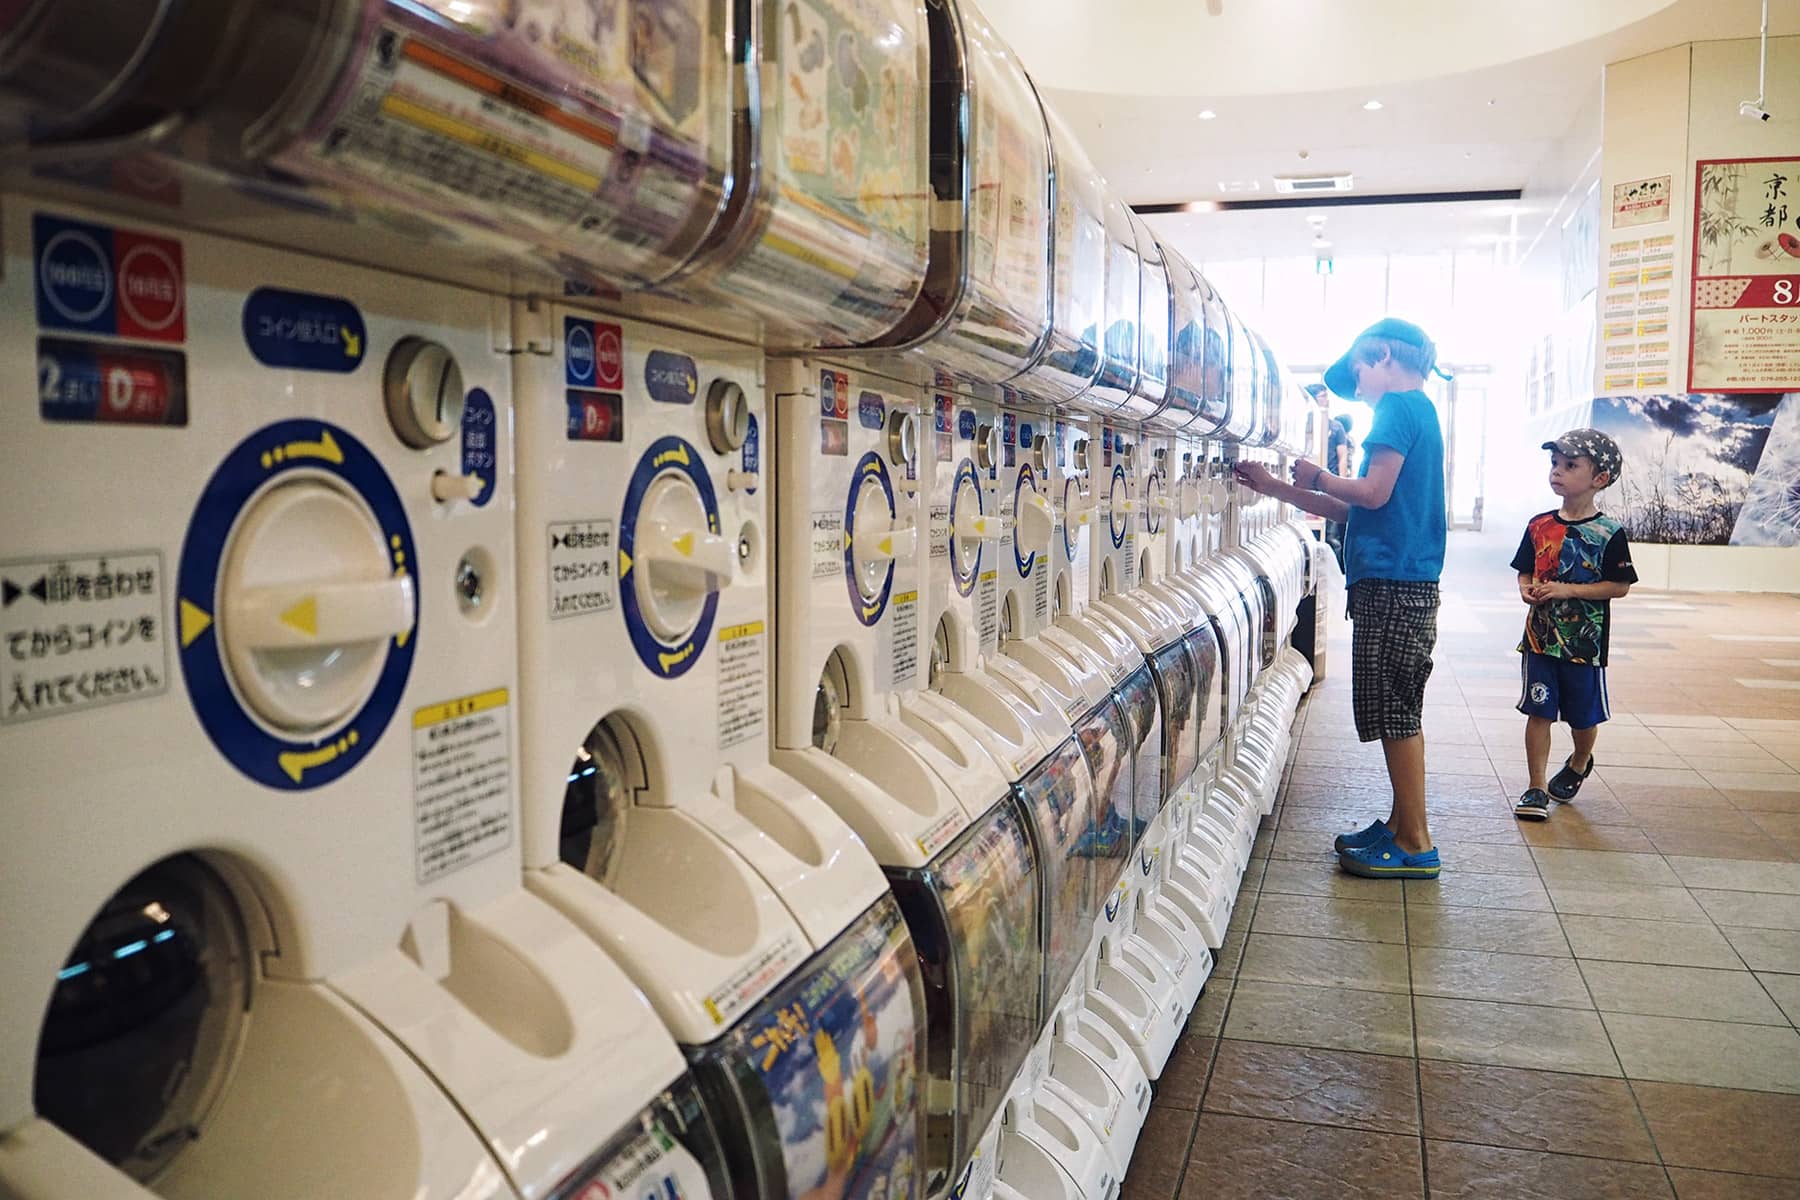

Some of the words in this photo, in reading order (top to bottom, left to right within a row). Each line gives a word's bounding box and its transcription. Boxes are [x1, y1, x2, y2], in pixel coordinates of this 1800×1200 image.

[1760, 173, 1788, 229] 京都
[1773, 279, 1800, 305] 8
[7, 615, 156, 661] てからコインを
